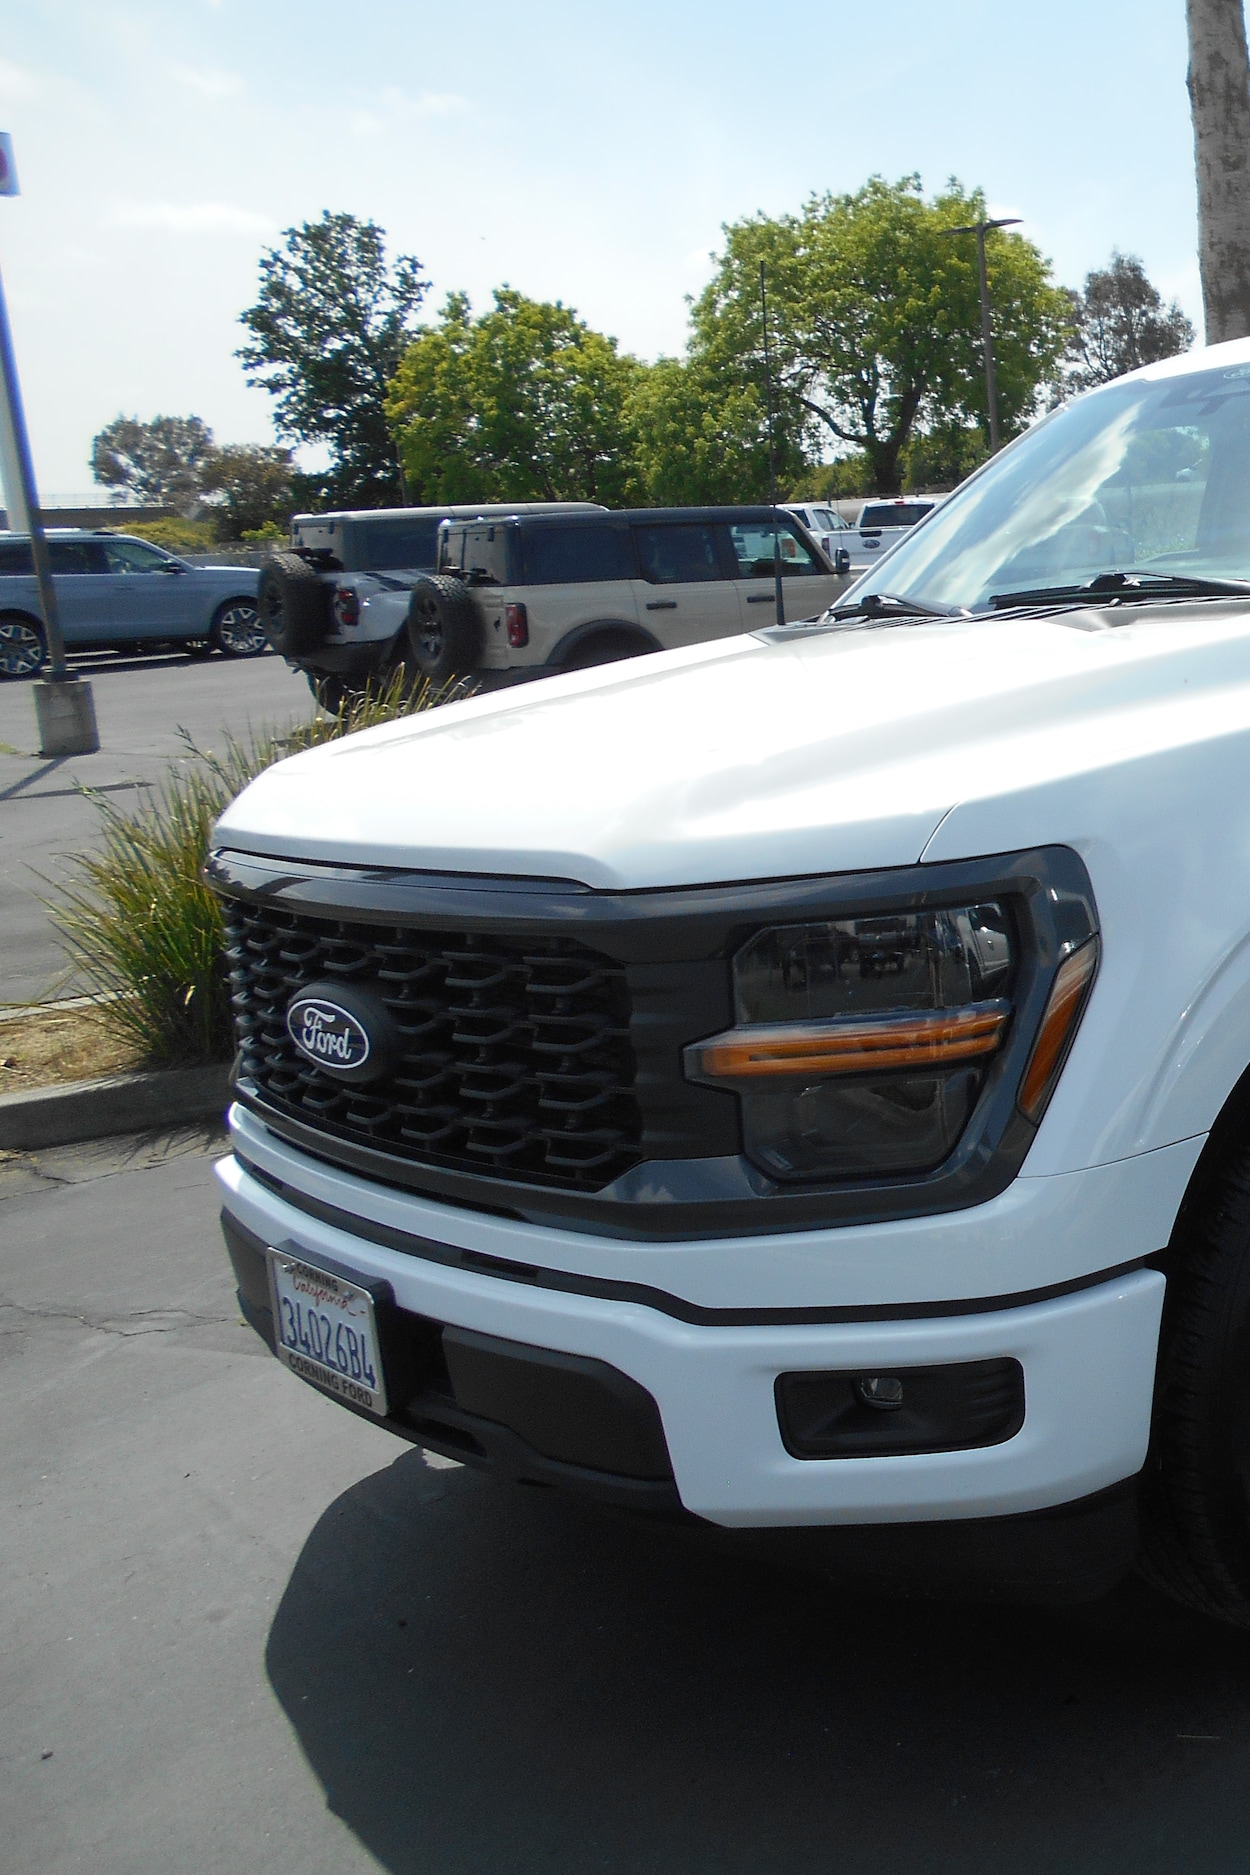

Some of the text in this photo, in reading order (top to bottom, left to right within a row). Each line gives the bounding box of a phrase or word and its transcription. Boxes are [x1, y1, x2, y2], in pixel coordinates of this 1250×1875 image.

[302, 1007, 352, 1060] Ford
[282, 1296, 377, 1390] 34026B4
[289, 1353, 373, 1408] CORNING FORD
